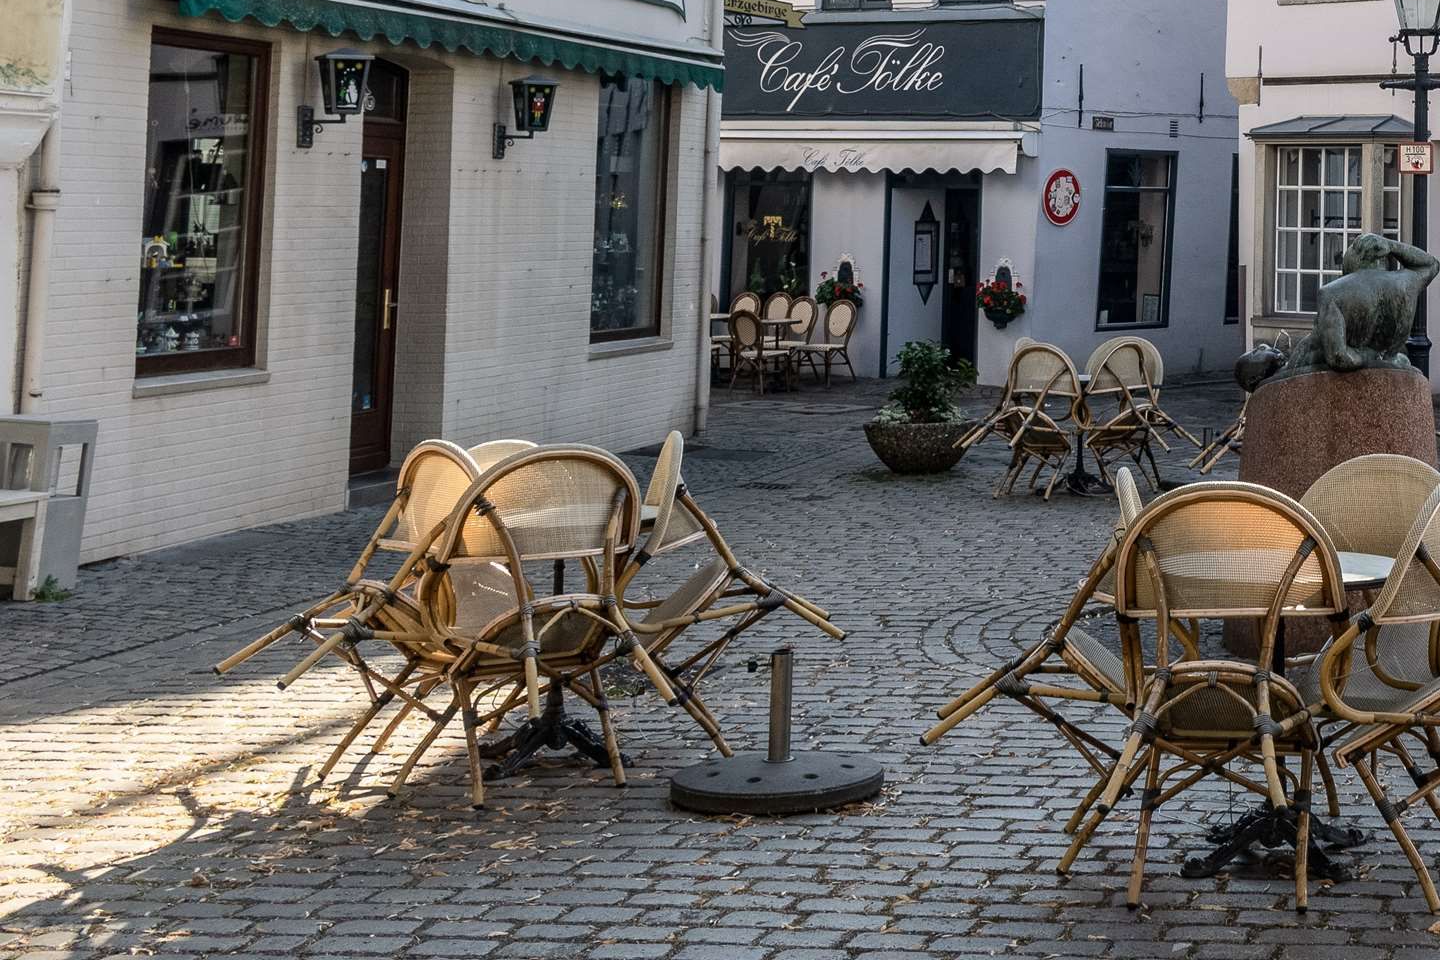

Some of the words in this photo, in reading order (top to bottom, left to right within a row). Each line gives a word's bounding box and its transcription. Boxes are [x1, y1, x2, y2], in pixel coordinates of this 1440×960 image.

[733, 33, 846, 112] Café
[837, 28, 945, 94] Tölke
[801, 146, 829, 170] Café
